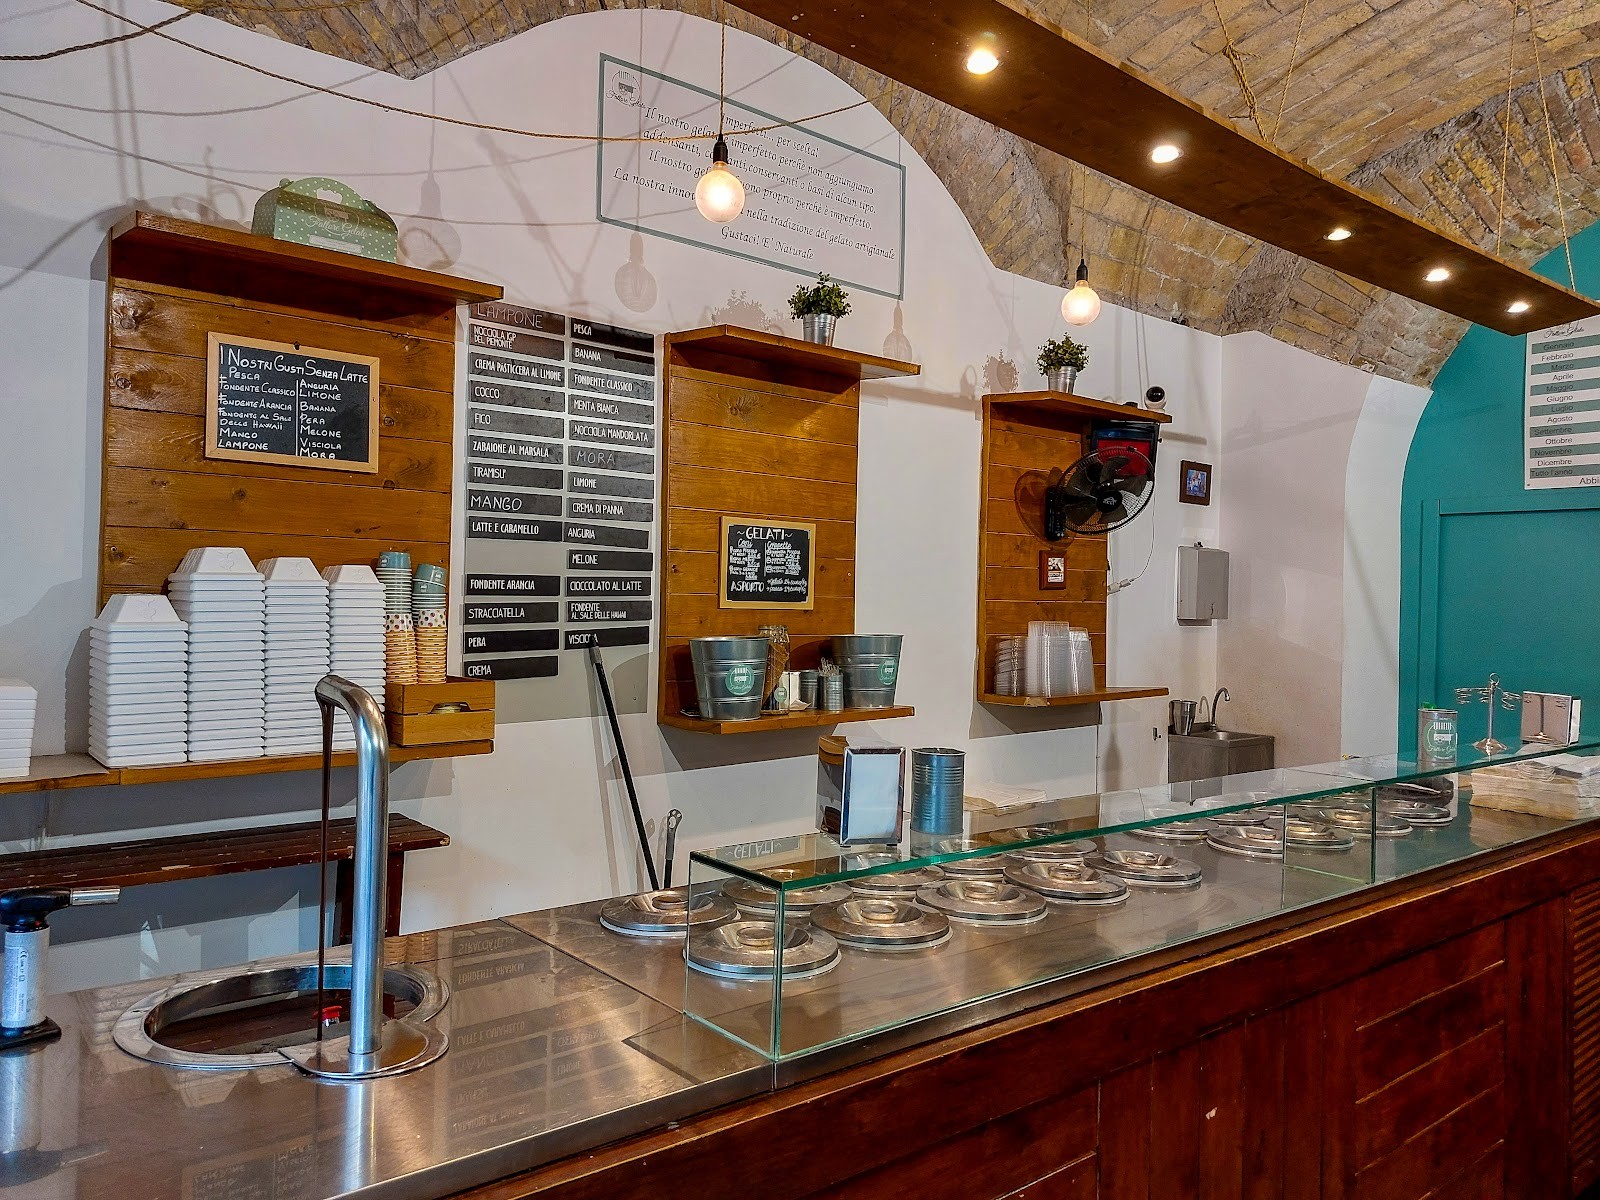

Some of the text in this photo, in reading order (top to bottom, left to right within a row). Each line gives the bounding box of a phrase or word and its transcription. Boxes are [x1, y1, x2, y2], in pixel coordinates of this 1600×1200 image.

[645, 107, 657, 119] Il
[657, 113, 689, 131] nostro
[691, 125, 718, 140] gela
[731, 136, 776, 161] imperfetto
[807, 163, 823, 178] non
[824, 170, 875, 195] aggiungiamo
[777, 136, 790, 148] per
[792, 141, 820, 158] scelta!
[649, 149, 660, 162] Il
[660, 154, 692, 173] nostro
[763, 187, 794, 205] proprio
[830, 208, 873, 231] imperfetto.
[807, 180, 825, 197] basi
[826, 187, 834, 200] di
[835, 192, 858, 208] alcun
[859, 199, 876, 214] tipo.
[613, 168, 629, 182] La
[632, 174, 665, 192] nostra
[746, 208, 769, 222] nella
[770, 217, 814, 236] tradizione
[815, 227, 829, 240] del
[829, 234, 854, 247] gelato
[854, 240, 896, 260] artigianale
[774, 241, 814, 260] Naturale
[477, 303, 544, 329] LAMPONE
[474, 326, 505, 341] NOCCIOLA
[573, 323, 592, 337] PESCA
[474, 335, 513, 350] DEL PIEMONTE
[1543, 342, 1575, 351] Gennaio
[575, 348, 601, 362] BANANA
[1541, 352, 1574, 361] Febbraio
[228, 348, 272, 370] NOSTRI
[274, 355, 304, 375] GUSTI
[305, 359, 338, 380] SENZA
[340, 365, 369, 383] LATTE
[475, 358, 562, 382] CREMA PASTICCERA AL LIMONE
[1551, 363, 1574, 371] Marzo
[229, 366, 260, 381] PESCA
[1552, 373, 1574, 381] Aprile
[219, 374, 260, 393] FONDENTE
[300, 378, 339, 391] ANGURIA
[574, 373, 633, 392] FONDENTE CLASSICO
[1546, 384, 1574, 393] Maggio
[299, 389, 342, 401] LIMONE
[475, 386, 500, 399] COCCO
[1546, 395, 1574, 403] Giugno
[218, 392, 292, 411] FONDENTE ARANCIA
[300, 401, 336, 412] BANANA
[574, 399, 619, 415] MENTA BIANCA
[1551, 405, 1574, 413] Luglio
[300, 412, 326, 425] PERA
[474, 412, 491, 424] FICO
[1547, 416, 1573, 424] Agosto
[300, 425, 341, 438] MELONE
[574, 424, 649, 442] NOCCIOLA MANDORLATA
[1534, 427, 1573, 436] Settembre
[218, 439, 269, 450] LAMPONE
[300, 437, 341, 450] VISCIOLA
[1545, 437, 1573, 445] Ottobre
[300, 447, 336, 459] MORA
[473, 441, 549, 458] ZABAIONE AL MARSALA
[1534, 448, 1572, 457] Novembre
[576, 450, 616, 466] MORA
[1537, 459, 1572, 467] Dicembre
[573, 476, 597, 489] LIMONE
[470, 495, 523, 512] MANGO
[572, 503, 624, 516] CREMA DI PANNA
[472, 521, 539, 534] LATTE E CARAMELLO
[567, 528, 596, 540] ANGURIA
[572, 553, 598, 565] MELONE
[470, 579, 535, 591] FONDENTE ARANCIA
[569, 580, 643, 591] CIOCCOLATO AL LATTE
[730, 581, 765, 592] ASPORTO
[468, 607, 525, 619] STRACCIATELLA
[571, 602, 600, 612] FONDENTE
[571, 612, 579, 620] AL
[579, 612, 594, 620] SALE
[594, 611, 610, 620] DELLE
[468, 636, 486, 647] PERA
[568, 633, 599, 645] VISCIOA
[467, 665, 492, 676] CREMA
